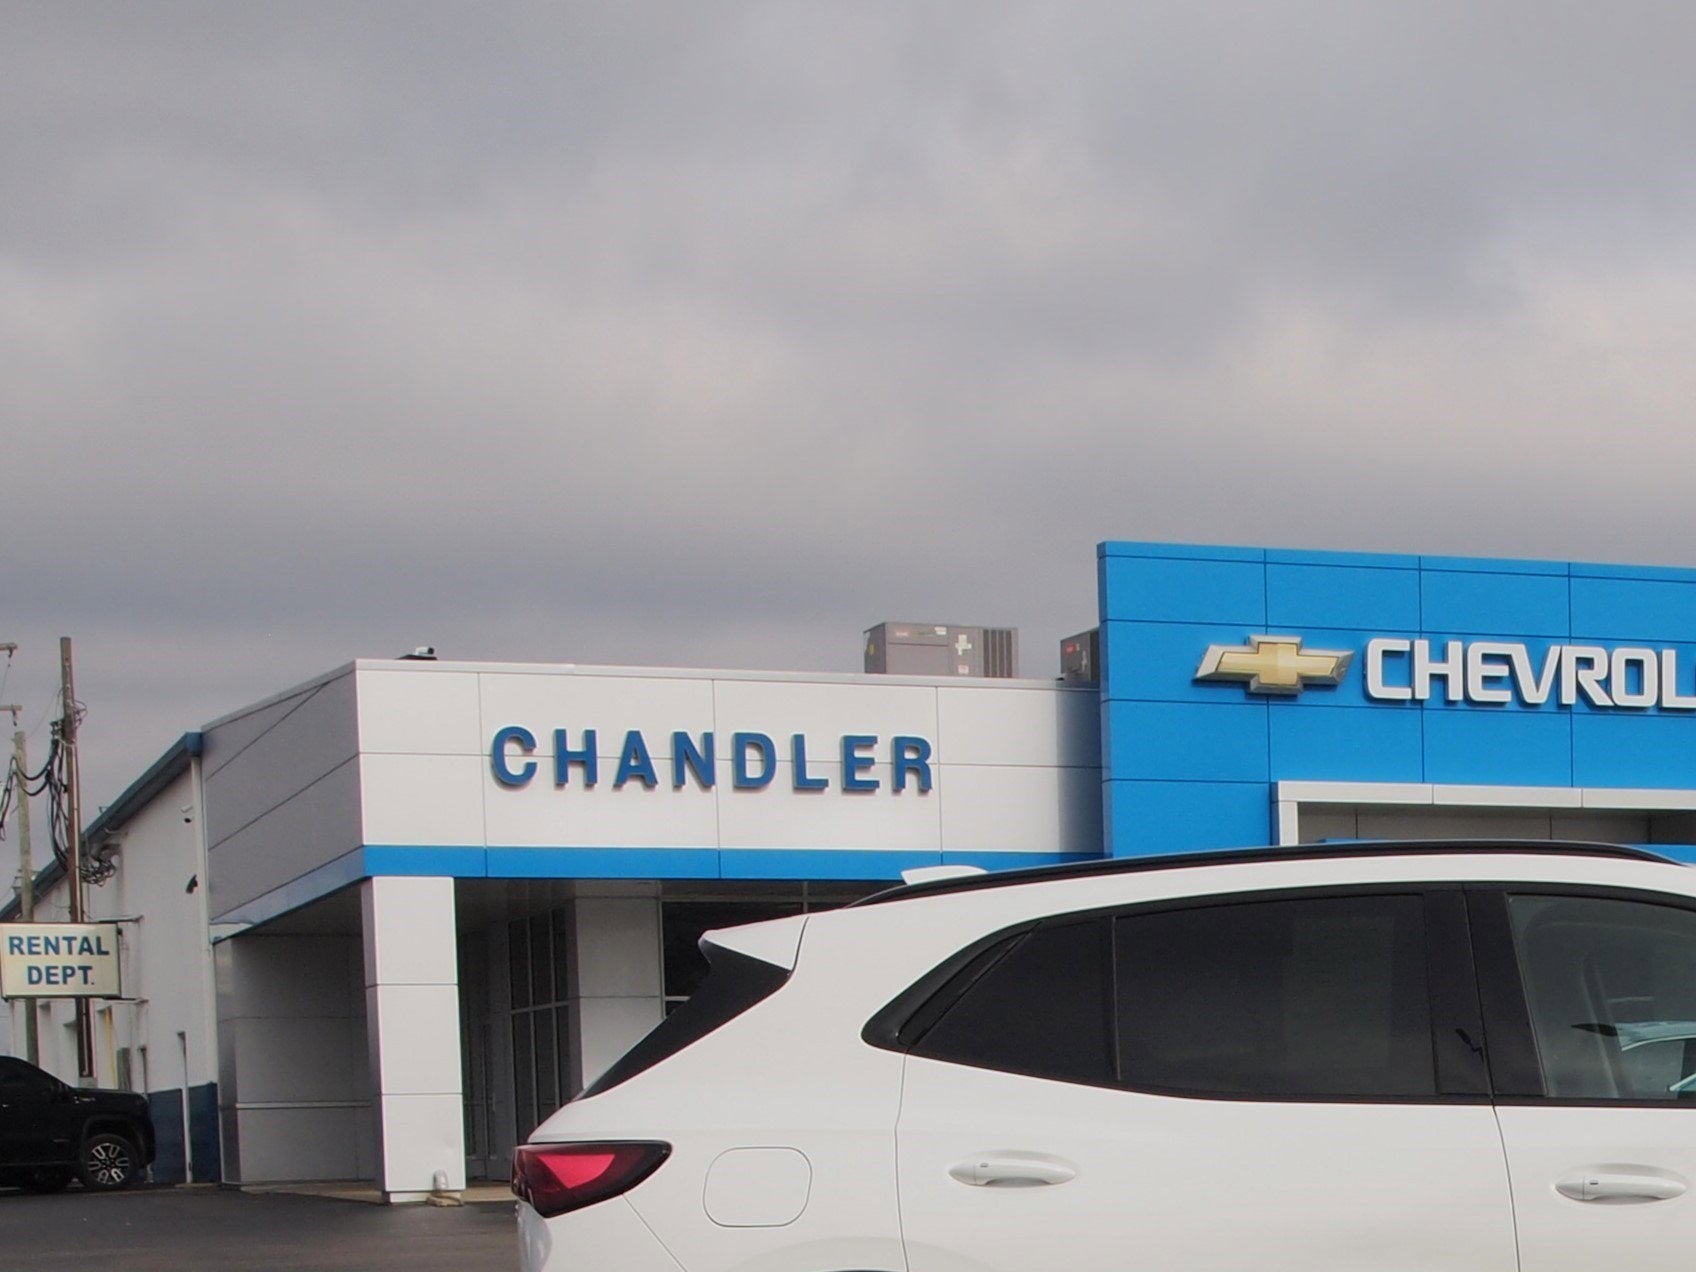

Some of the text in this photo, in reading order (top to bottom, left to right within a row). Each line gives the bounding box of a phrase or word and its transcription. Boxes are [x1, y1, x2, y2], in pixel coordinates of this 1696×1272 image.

[493, 726, 932, 791] CHANDLER
[9, 935, 110, 956] RENTAL
[27, 965, 95, 986] DEPT.
